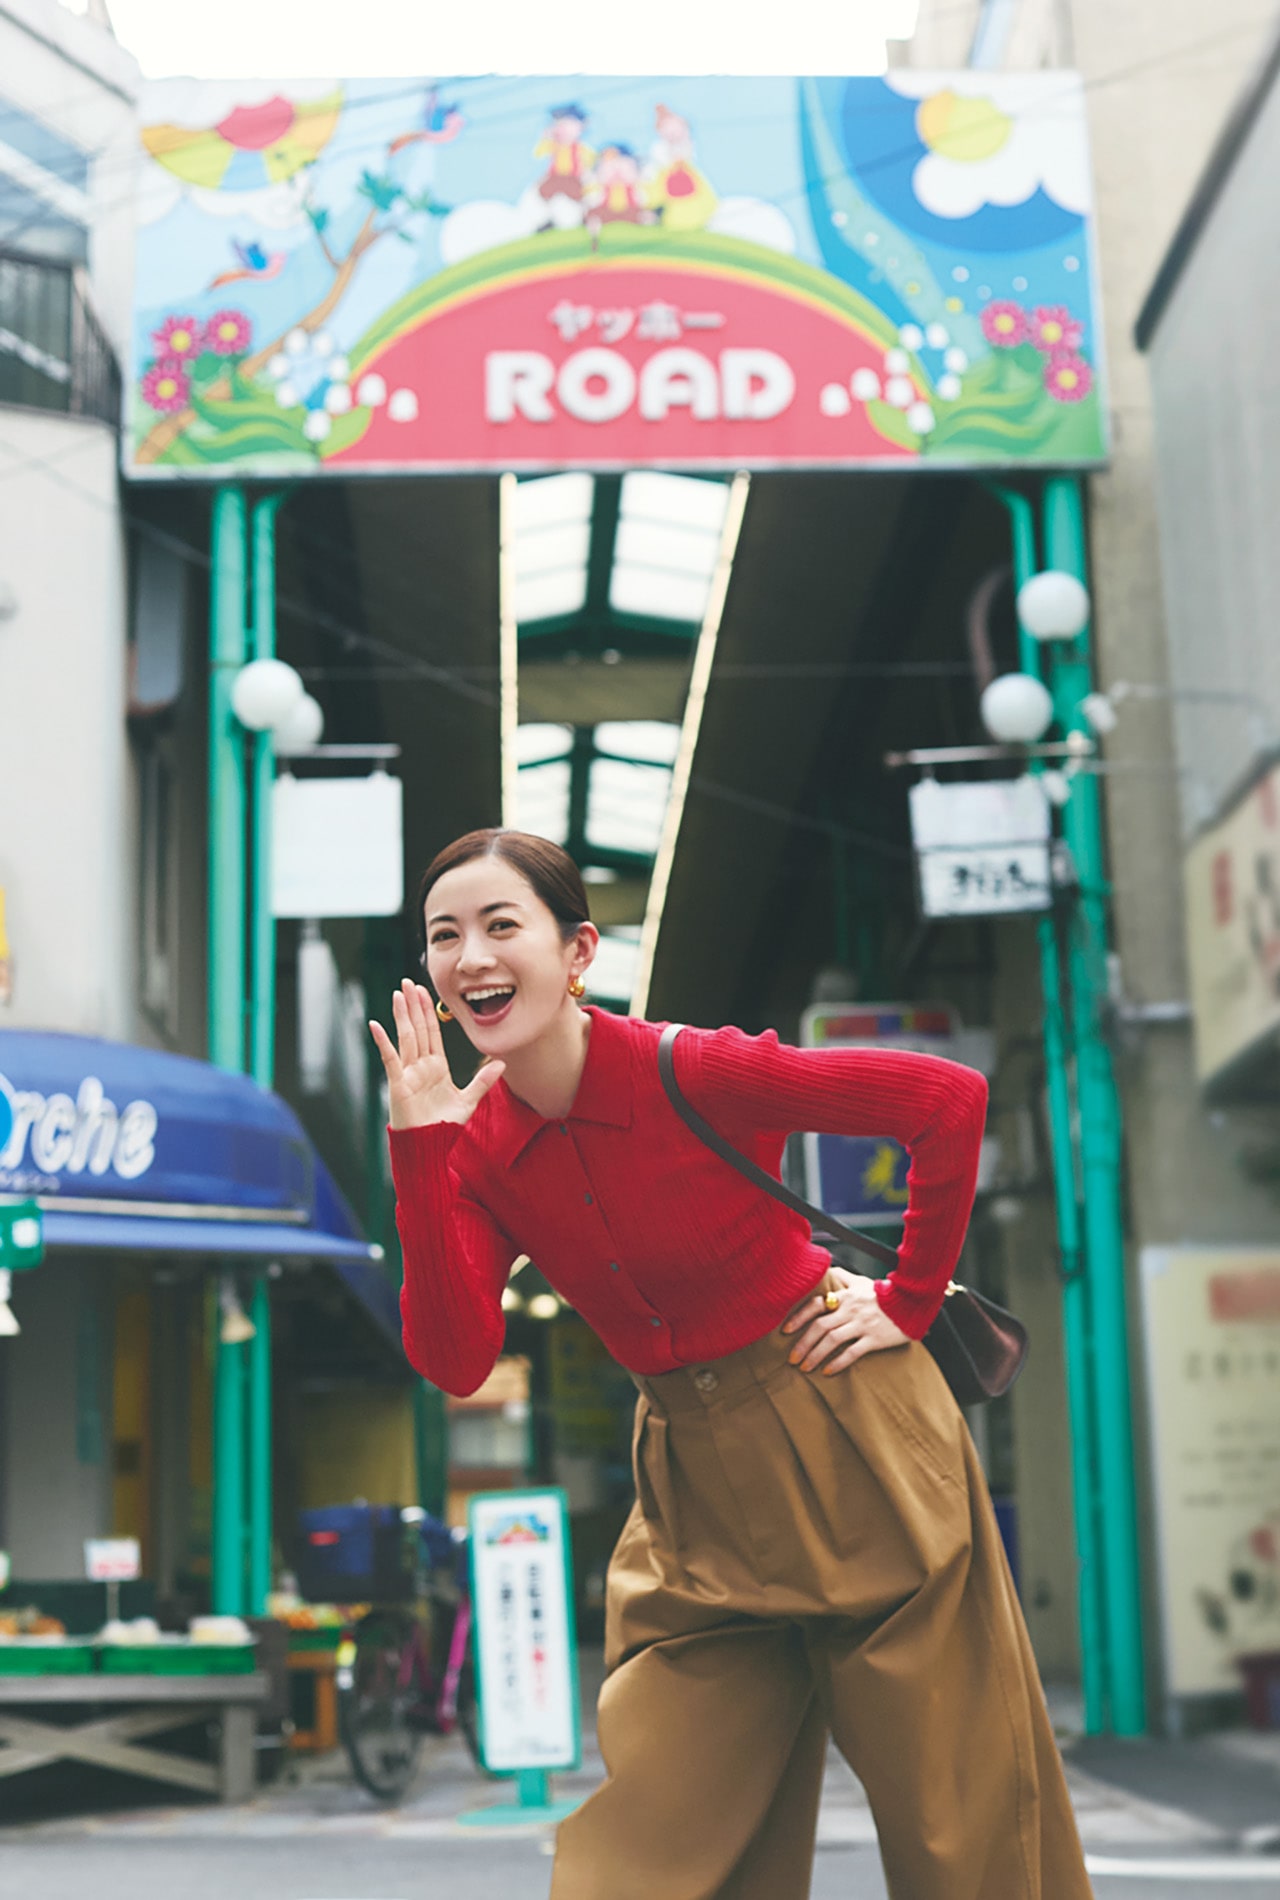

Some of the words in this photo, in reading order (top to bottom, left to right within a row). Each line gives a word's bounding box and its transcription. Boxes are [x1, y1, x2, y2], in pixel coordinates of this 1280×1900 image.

[549, 299, 724, 342] ヤッホー
[486, 347, 795, 423] ROAD
